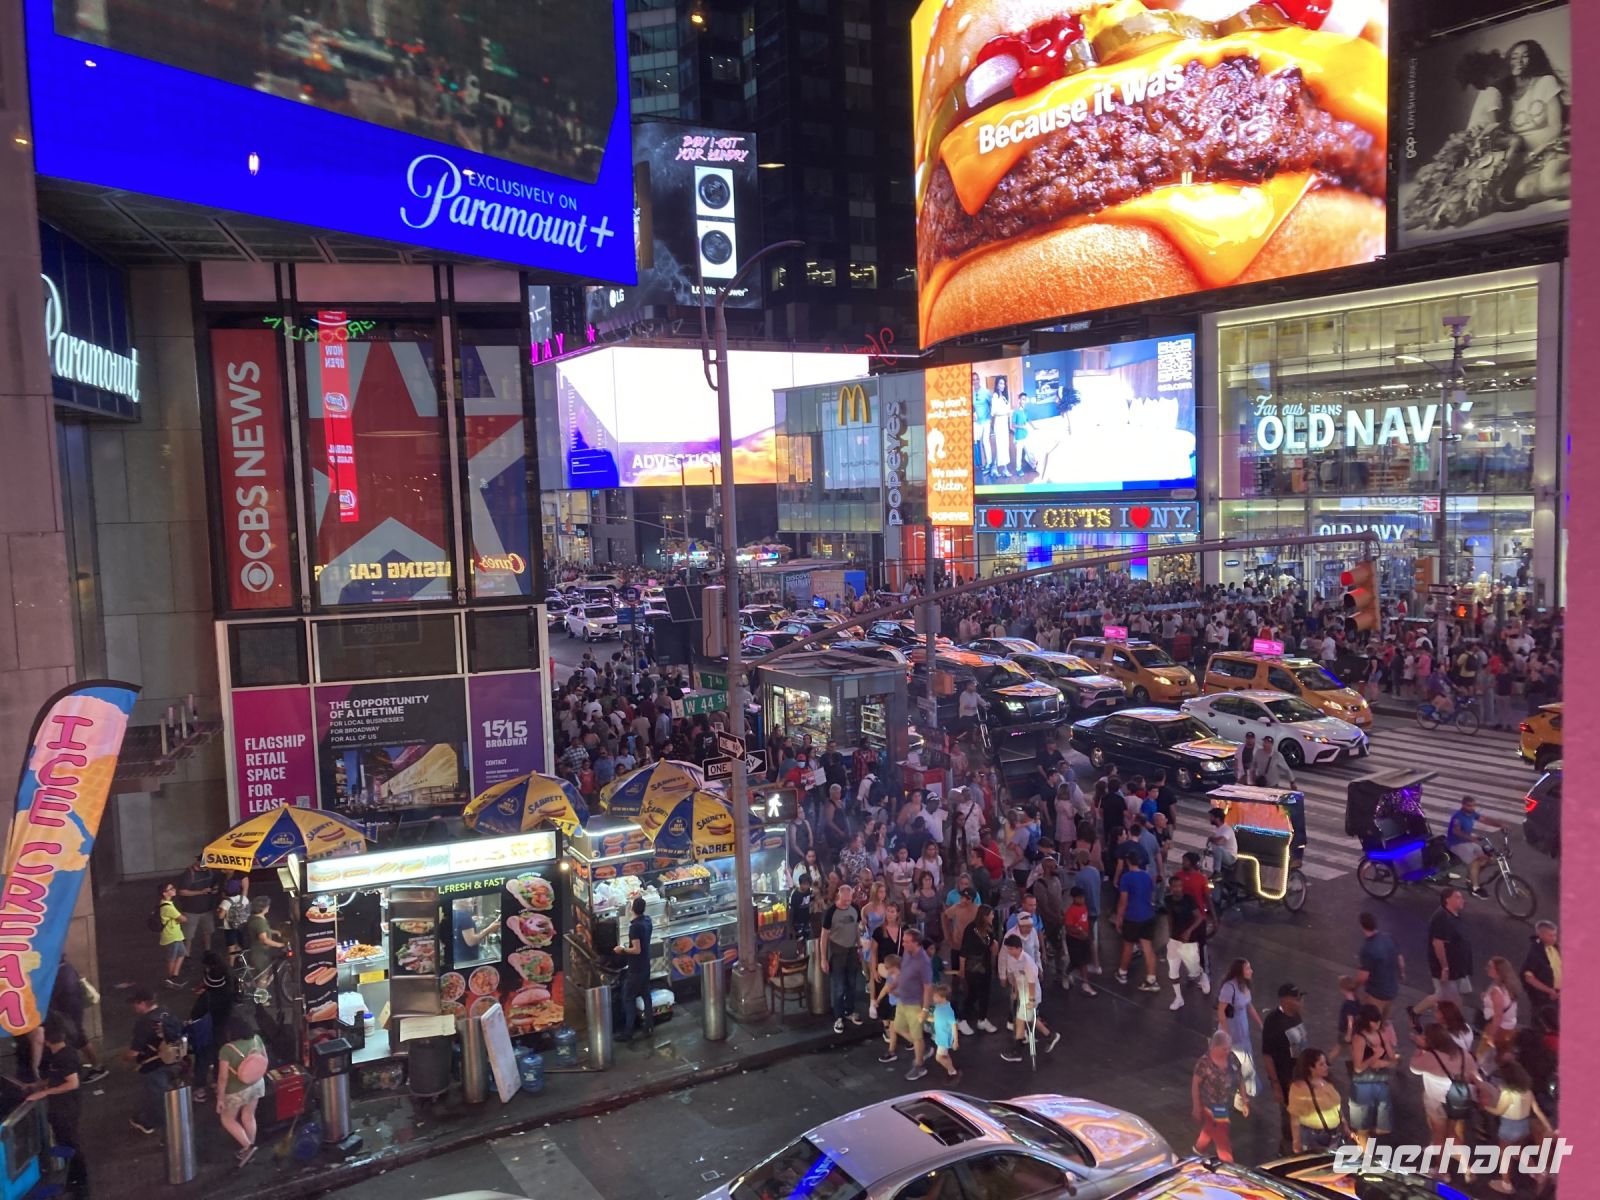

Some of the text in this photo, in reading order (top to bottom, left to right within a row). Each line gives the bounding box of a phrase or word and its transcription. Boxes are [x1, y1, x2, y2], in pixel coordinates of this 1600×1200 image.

[979, 97, 1087, 154] Because
[1094, 83, 1115, 117] it
[467, 172, 578, 211] EXCLUSIVELY ON
[615, 289, 625, 301] LG
[41, 273, 140, 403] Paramount
[227, 361, 267, 477] NEWS
[1257, 413, 1335, 450] OLD
[632, 452, 721, 469] ADVECTION
[236, 485, 271, 559] CBS
[979, 511, 988, 528] I
[1042, 507, 1112, 528] GIFTS
[1119, 510, 1129, 528] I
[329, 695, 430, 710] THE OPPORTUNITY
[685, 694, 726, 713] W 44 St
[329, 706, 404, 719] OF A LIFETIME
[365, 716, 405, 725] BUSINESSES
[344, 726, 380, 734] BROADWAY
[244, 734, 306, 751] FLAGSHIP
[485, 737, 528, 748] BROADWAY
[245, 751, 288, 767] RETAIL
[29, 715, 94, 828] ICE
[246, 767, 287, 782] SPACE
[710, 763, 728, 774] ONE
[247, 783, 273, 798] FOR
[527, 796, 563, 815] SABRETT
[305, 821, 334, 842] SABRETT
[695, 843, 736, 856] SABRET
[206, 853, 253, 867] SABRETT
[473, 880, 483, 889] &
[484, 877, 506, 888] FAST
